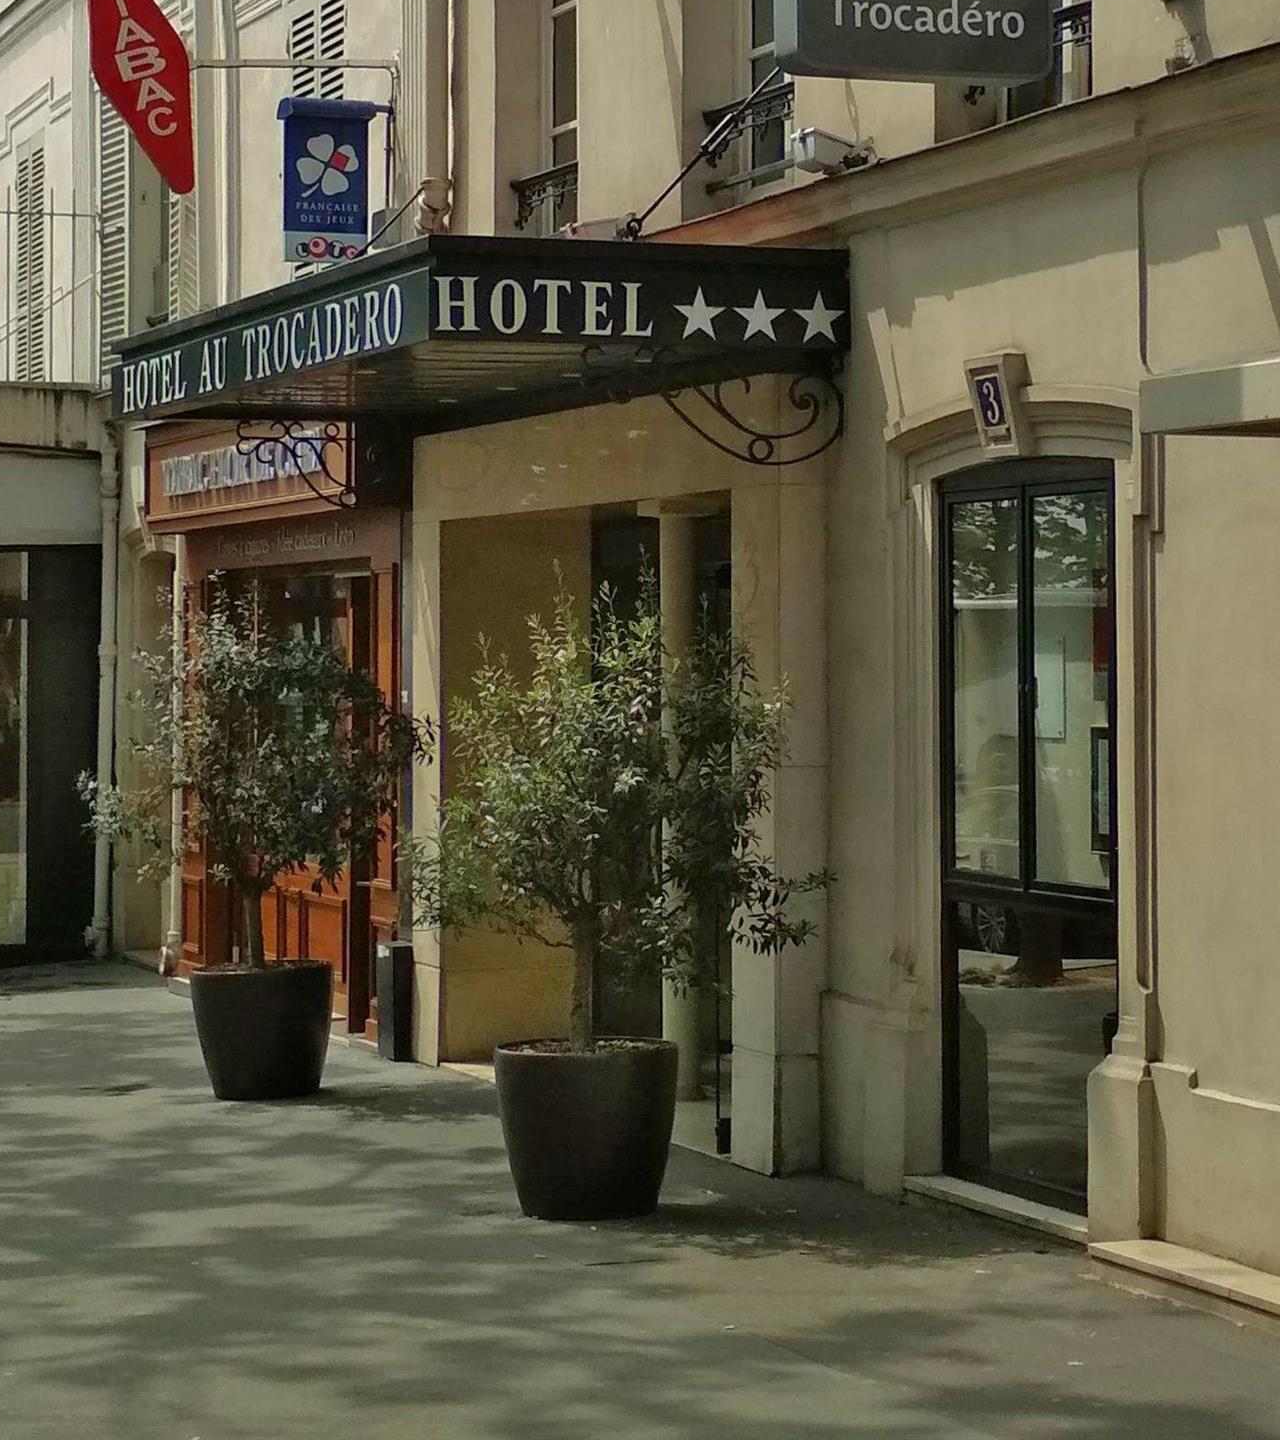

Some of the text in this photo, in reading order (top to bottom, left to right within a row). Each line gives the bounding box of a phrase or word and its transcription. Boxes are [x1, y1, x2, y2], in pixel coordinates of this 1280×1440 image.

[295, 201, 360, 214] FRANÇAISE
[300, 214, 355, 225] DES JEUX
[432, 275, 655, 338] HOTEL
[122, 282, 404, 414] HOTEL AU TROCADERO
[982, 381, 1000, 424] 3
